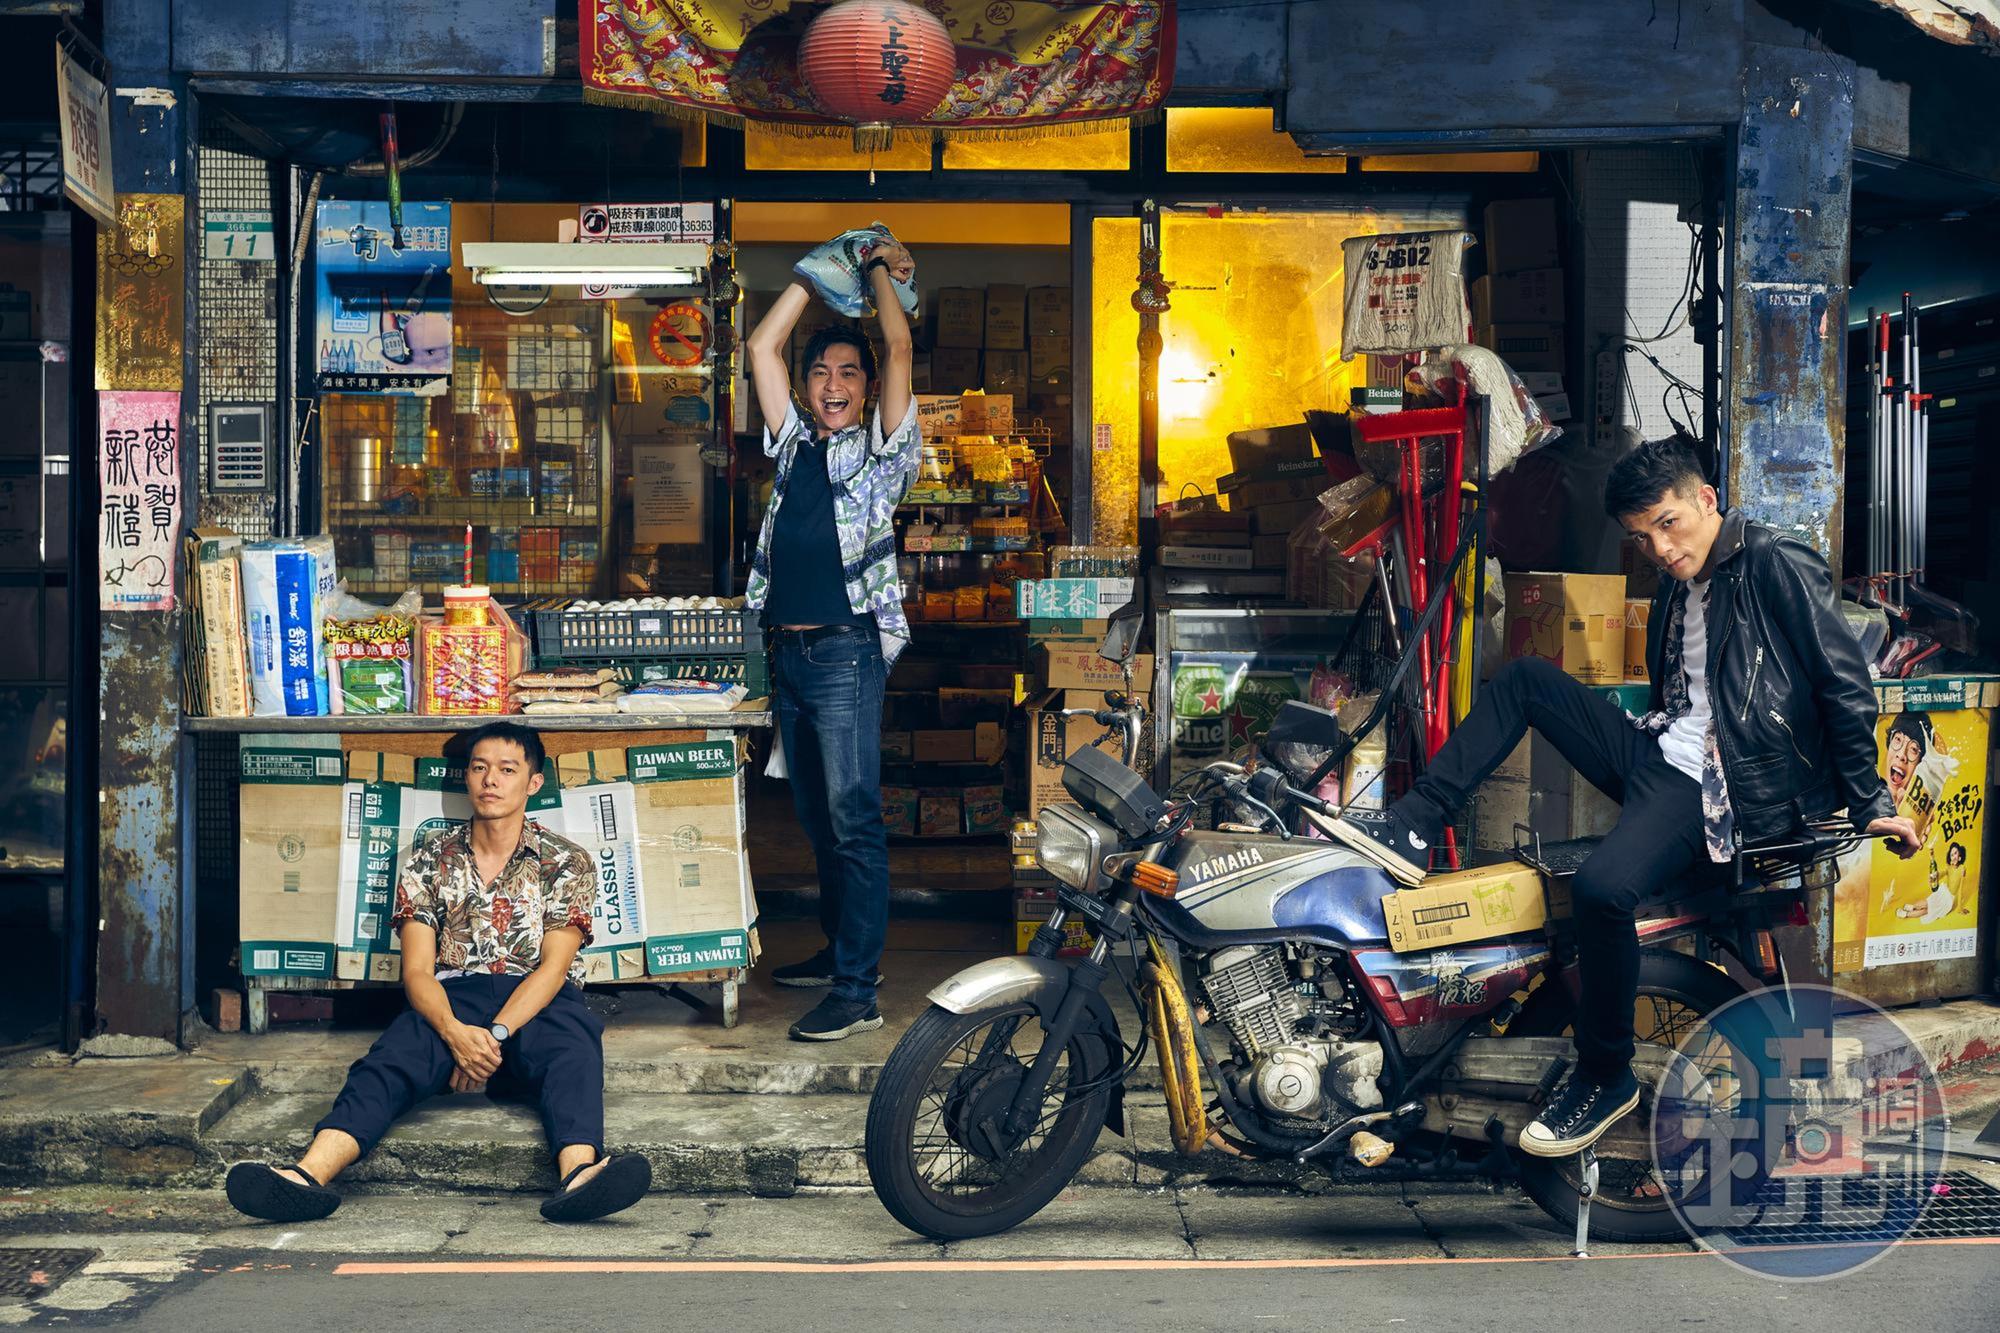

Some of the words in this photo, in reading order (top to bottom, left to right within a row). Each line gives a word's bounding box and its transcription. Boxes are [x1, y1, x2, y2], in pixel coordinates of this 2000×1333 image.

[877, 4, 909, 105] 天上聖母
[211, 213, 270, 222] 八德路二段
[609, 207, 683, 220] 吸菸有害健康
[223, 234, 258, 257] 11
[322, 377, 380, 388] 酒後不開車
[1277, 461, 1319, 472] Heineken
[104, 429, 142, 550] 新禧
[1036, 583, 1096, 615] 生茶
[288, 626, 309, 669] 舒潔
[335, 642, 409, 657] 限量熱賣包
[1041, 713, 1057, 754] 金門
[635, 751, 684, 766] TAIWAN
[688, 748, 725, 762] BEER
[1909, 775, 1935, 817] Bar
[364, 841, 391, 904] 台灣啤酒
[1188, 847, 1264, 883] YAMAHA
[600, 846, 622, 935] CLASSIC
[658, 952, 691, 967] BEER
[695, 947, 743, 963] TAIWAN
